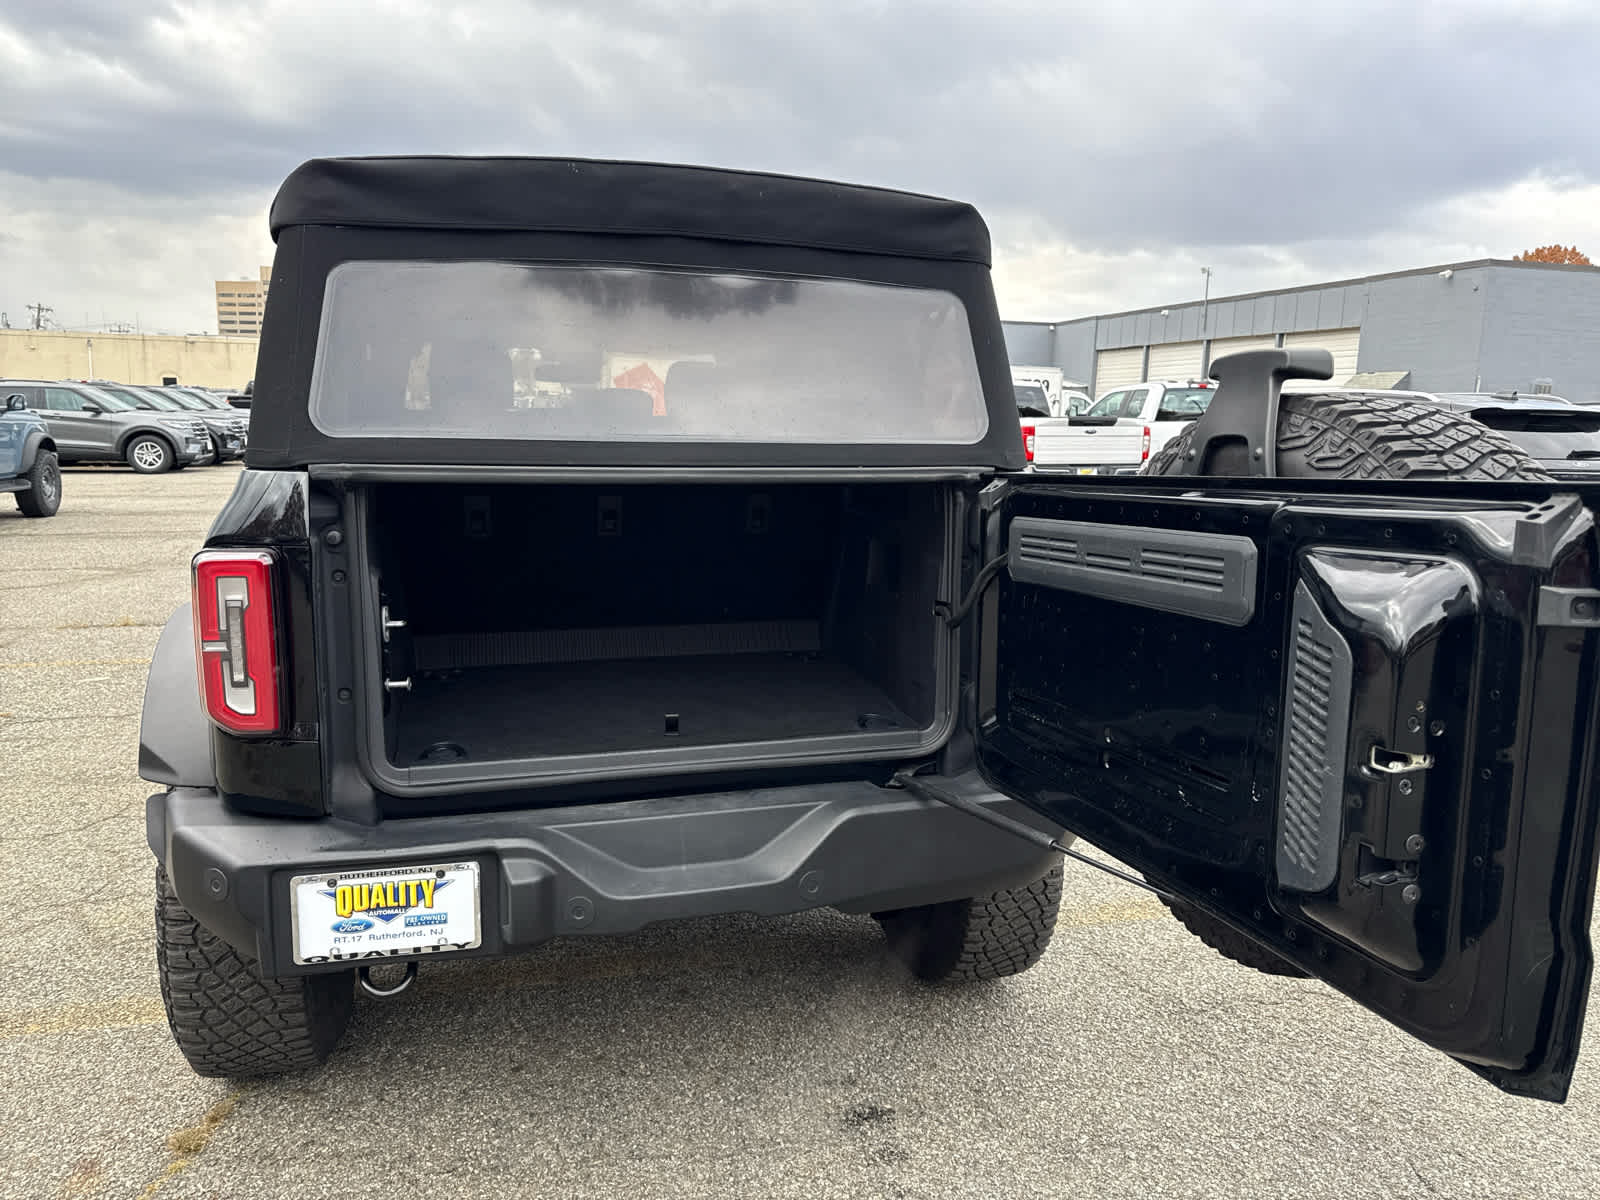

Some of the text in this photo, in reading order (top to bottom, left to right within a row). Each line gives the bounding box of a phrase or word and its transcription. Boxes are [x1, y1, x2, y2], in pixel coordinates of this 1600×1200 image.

[335, 878, 437, 918] QUALITY
[368, 907, 406, 917] AUTOMALL
[430, 927, 444, 935] NJ
